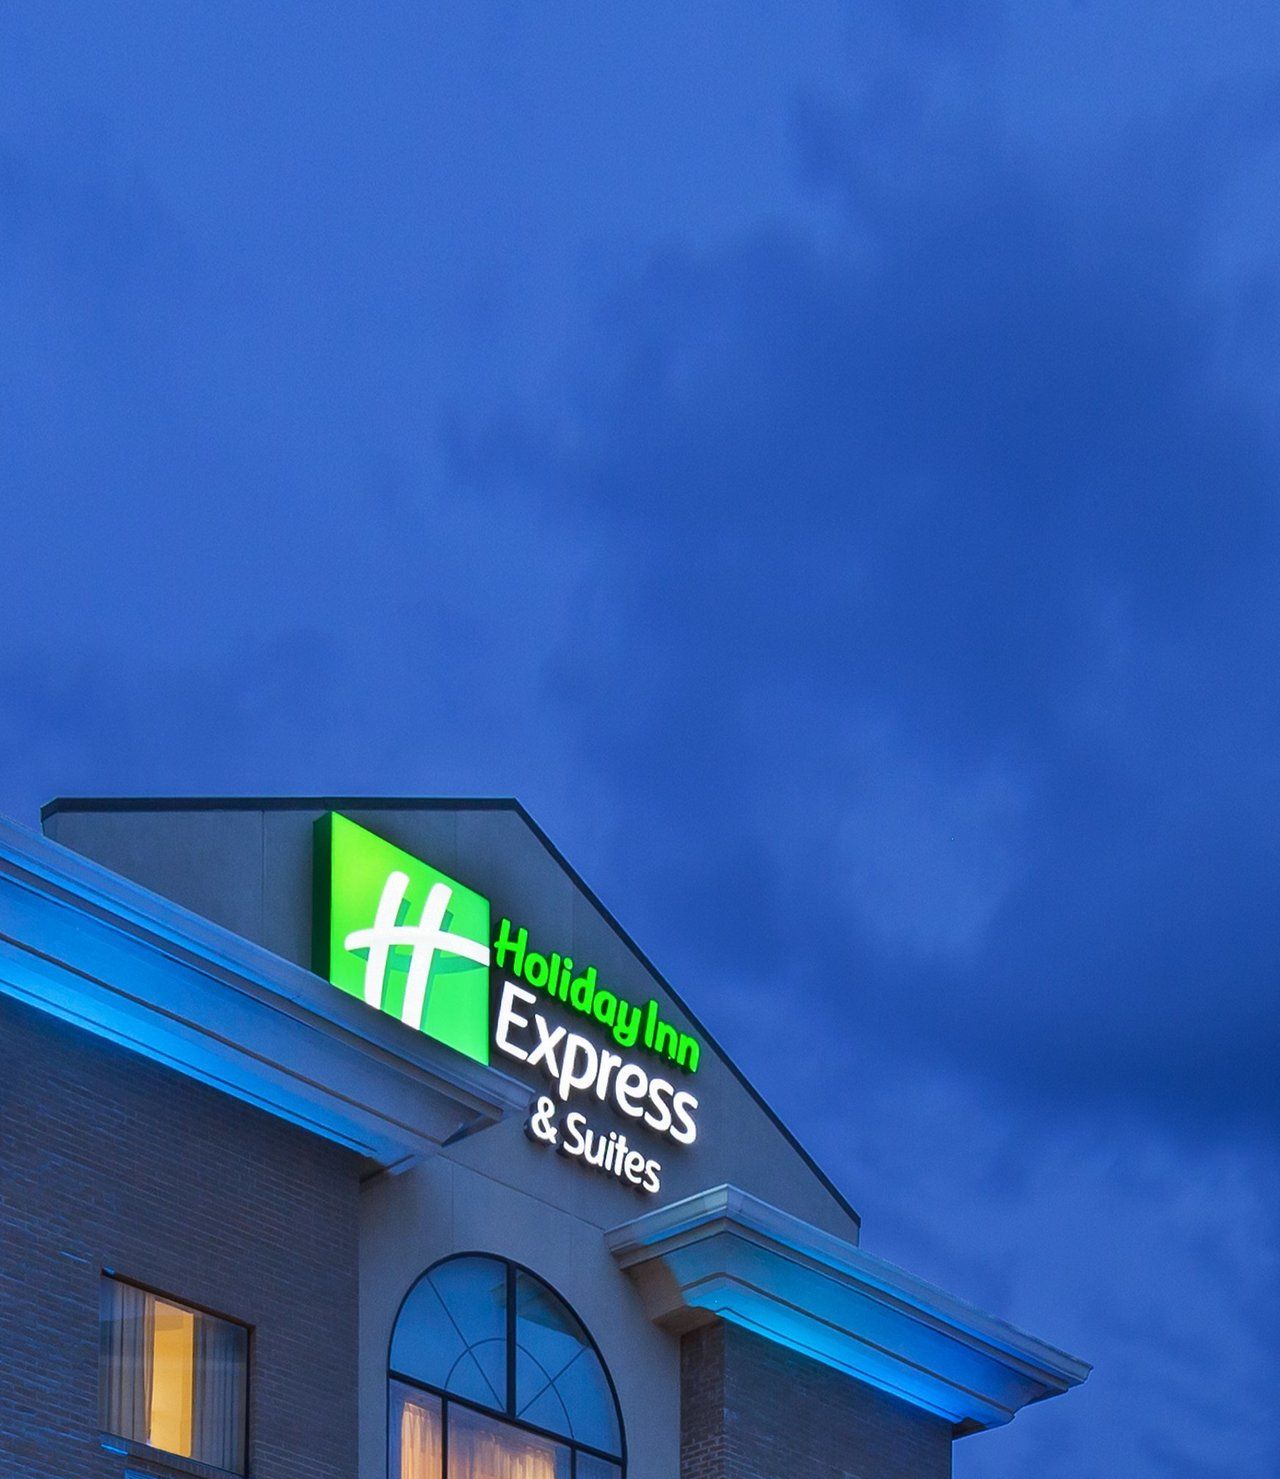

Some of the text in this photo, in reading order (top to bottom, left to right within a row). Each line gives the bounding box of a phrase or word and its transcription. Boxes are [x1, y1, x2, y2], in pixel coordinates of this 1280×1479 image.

[493, 918, 701, 1074] Holiday Inn
[495, 980, 699, 1145] Express
[530, 1096, 662, 1194] & Suites
